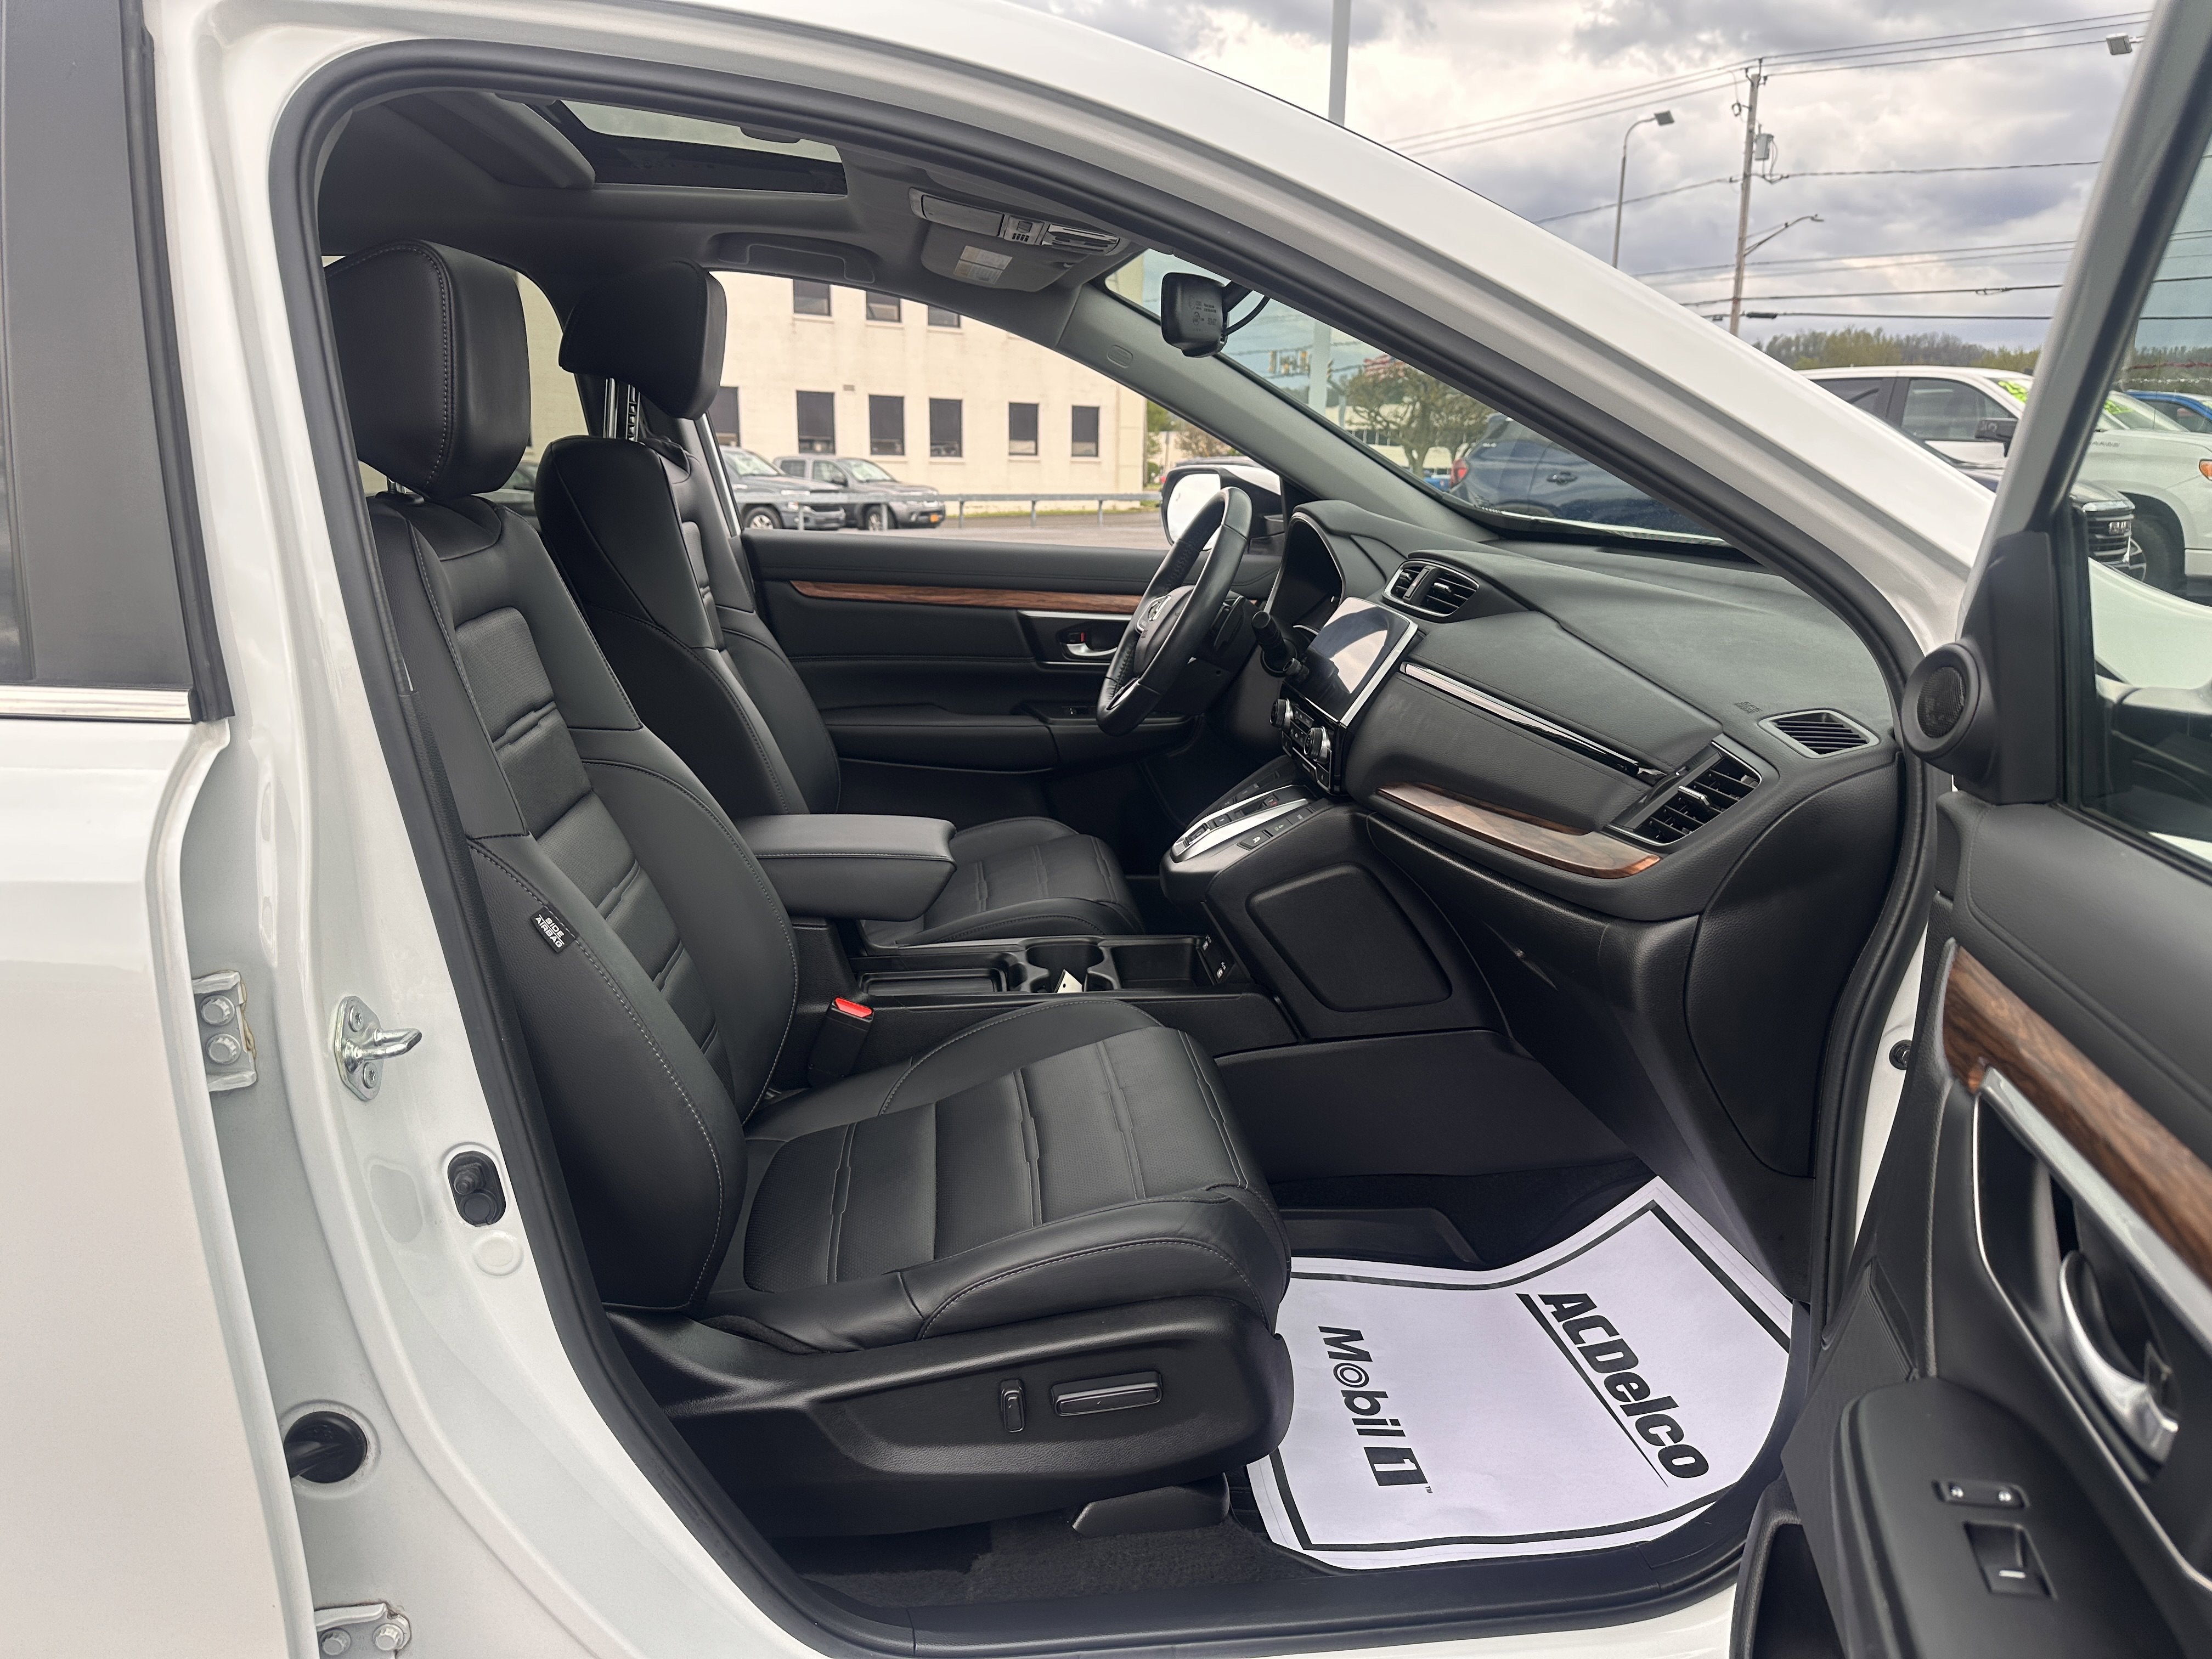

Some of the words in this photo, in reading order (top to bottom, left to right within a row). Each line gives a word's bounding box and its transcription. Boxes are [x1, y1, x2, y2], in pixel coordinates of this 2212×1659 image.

[535, 917, 563, 948] AIRBAG
[545, 917, 565, 938] SIDE
[1318, 1325, 1406, 1437] Mobil
[1538, 1293, 1709, 1479] ACDelco
